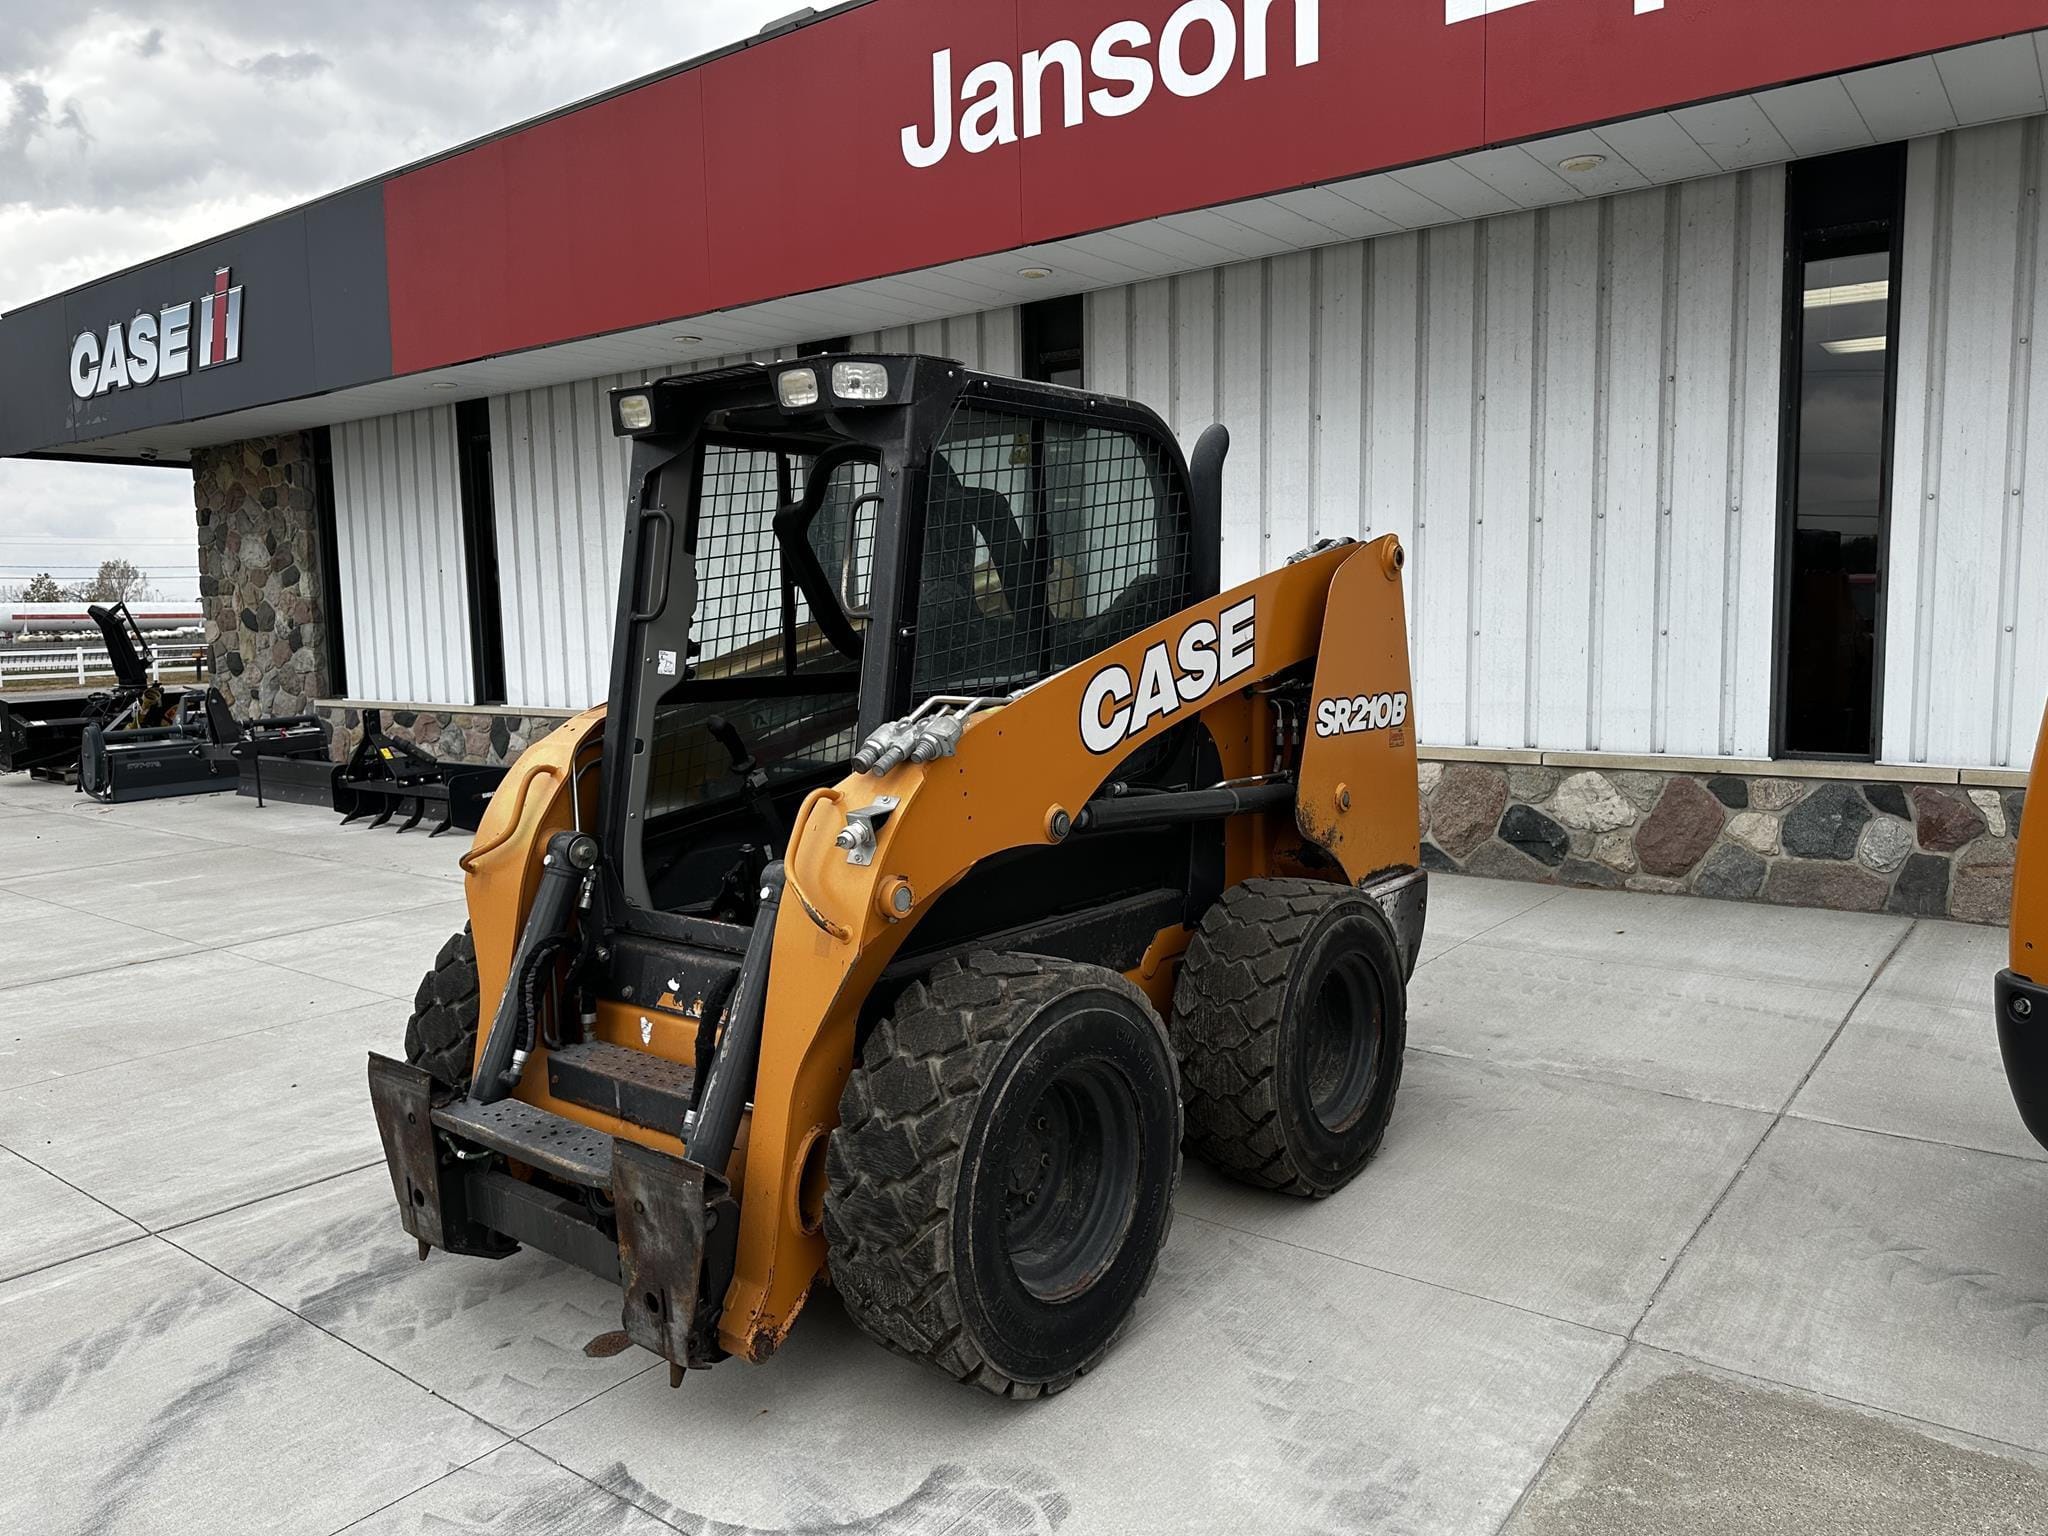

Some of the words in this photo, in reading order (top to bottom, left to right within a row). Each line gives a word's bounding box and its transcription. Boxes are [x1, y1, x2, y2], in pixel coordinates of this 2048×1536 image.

[900, 0, 1320, 169] Janson
[70, 302, 192, 399] CASE
[1080, 595, 1256, 754] CASE
[1315, 691, 1408, 738] SR210B
